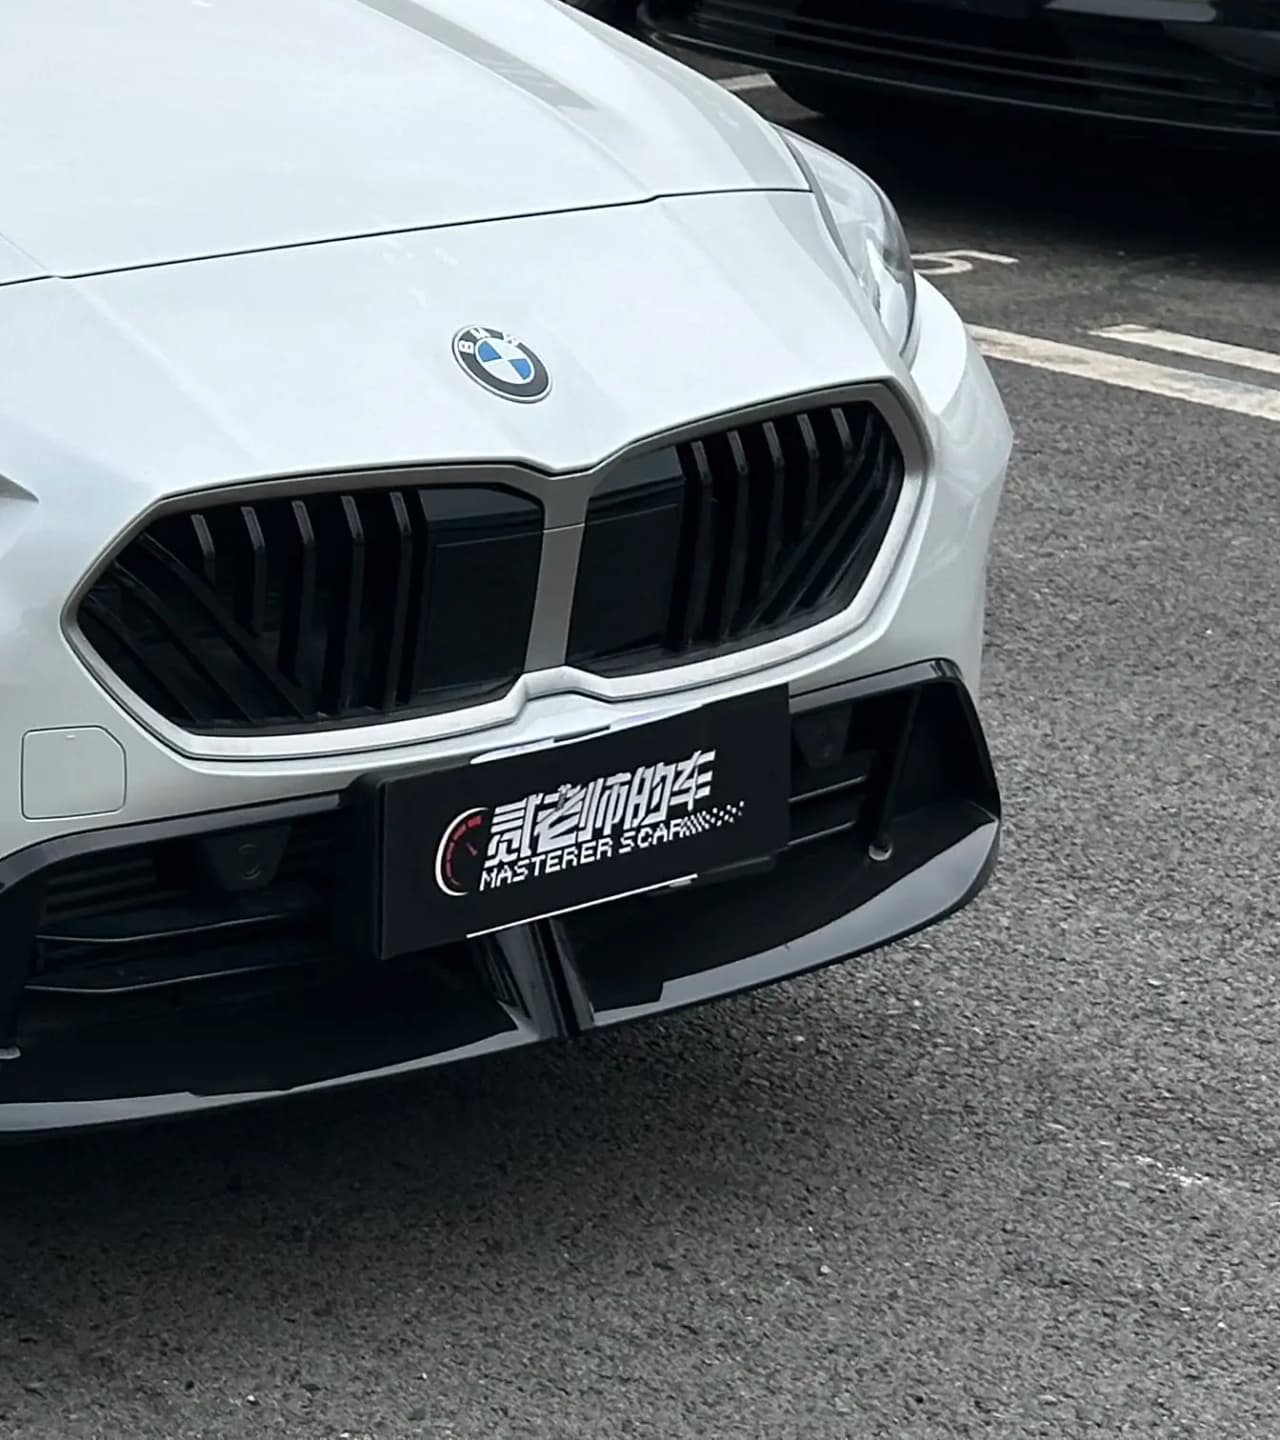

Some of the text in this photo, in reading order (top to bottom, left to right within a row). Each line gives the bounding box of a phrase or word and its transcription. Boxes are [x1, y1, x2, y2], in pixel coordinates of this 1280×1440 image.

[484, 749, 716, 869] 贰老师的车
